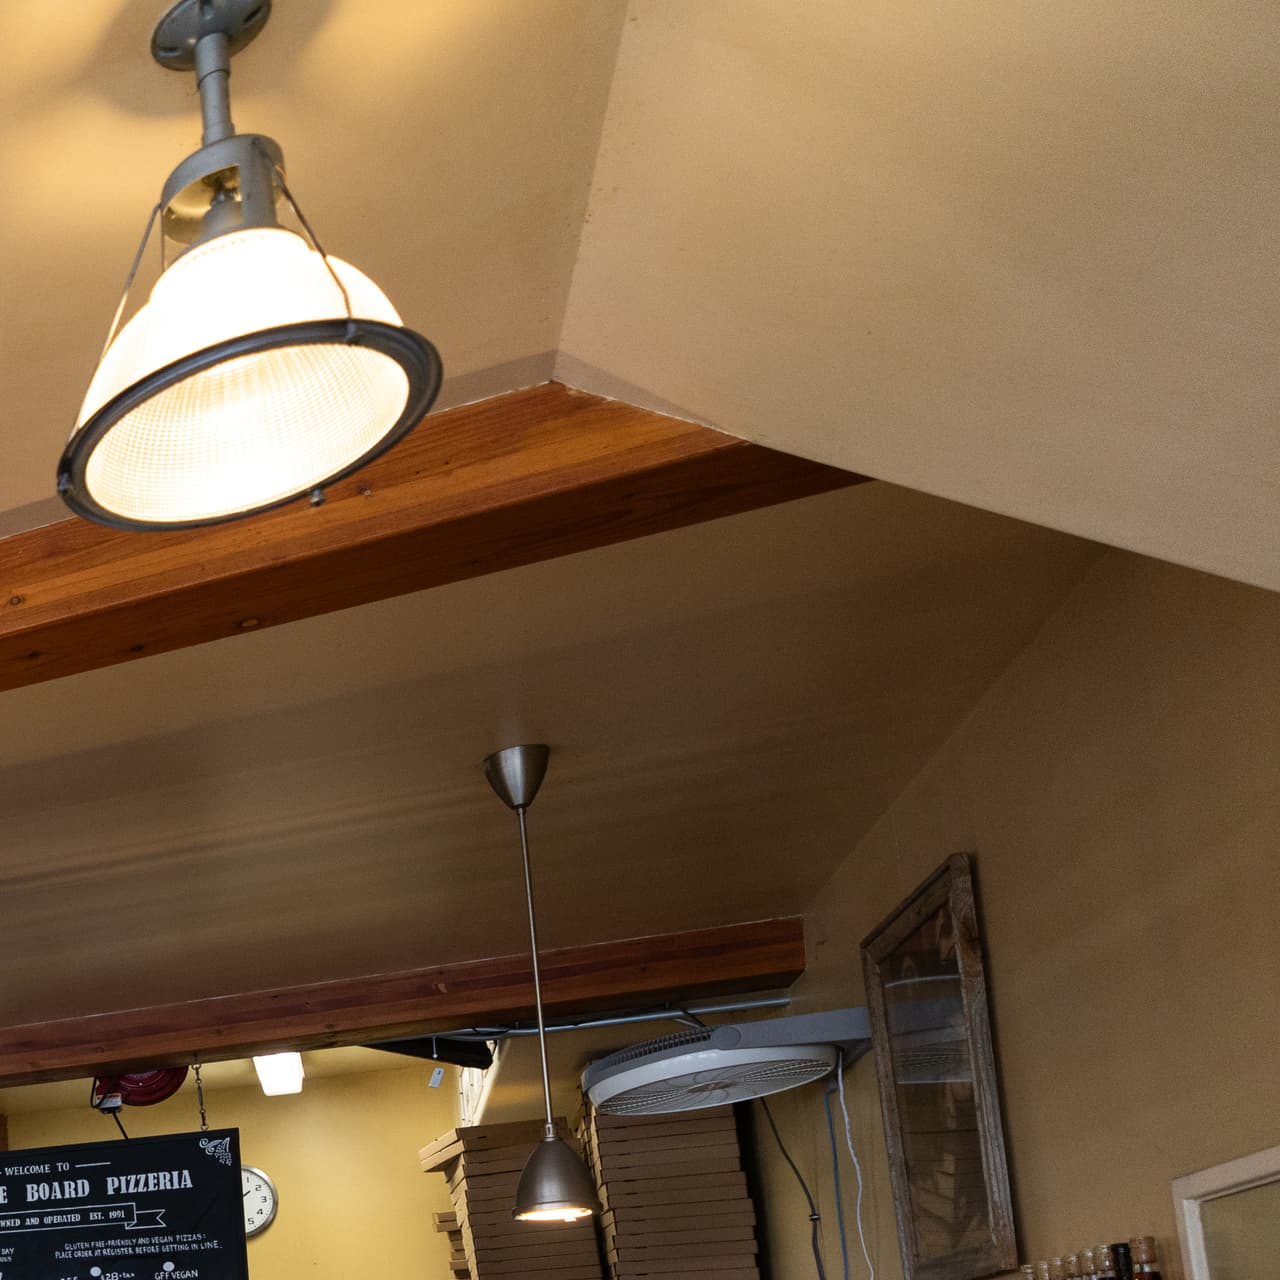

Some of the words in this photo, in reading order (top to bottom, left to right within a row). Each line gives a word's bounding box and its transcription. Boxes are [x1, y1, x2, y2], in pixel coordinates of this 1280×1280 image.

[5, 1164, 51, 1176] WELCOME
[56, 1162, 70, 1172] TO
[26, 1179, 90, 1202] BOARD
[106, 1169, 193, 1196] PIZZERIA
[25, 1217, 39, 1226] AND
[44, 1214, 81, 1224] OPERATED
[90, 1212, 105, 1221] EST.
[109, 1210, 125, 1219] 1991
[248, 1217, 255, 1225] 5
[151, 1236, 173, 1244] VEGAN
[55, 1251, 72, 1259] PLACE
[74, 1250, 93, 1258] ORDER
[94, 1249, 102, 1257] AT
[103, 1248, 134, 1257] REGISTER
[135, 1246, 160, 1255] BEFORE
[161, 1244, 189, 1253] GETTING
[155, 1272, 170, 1280] GFF
[170, 1269, 199, 1278] VEGAN
